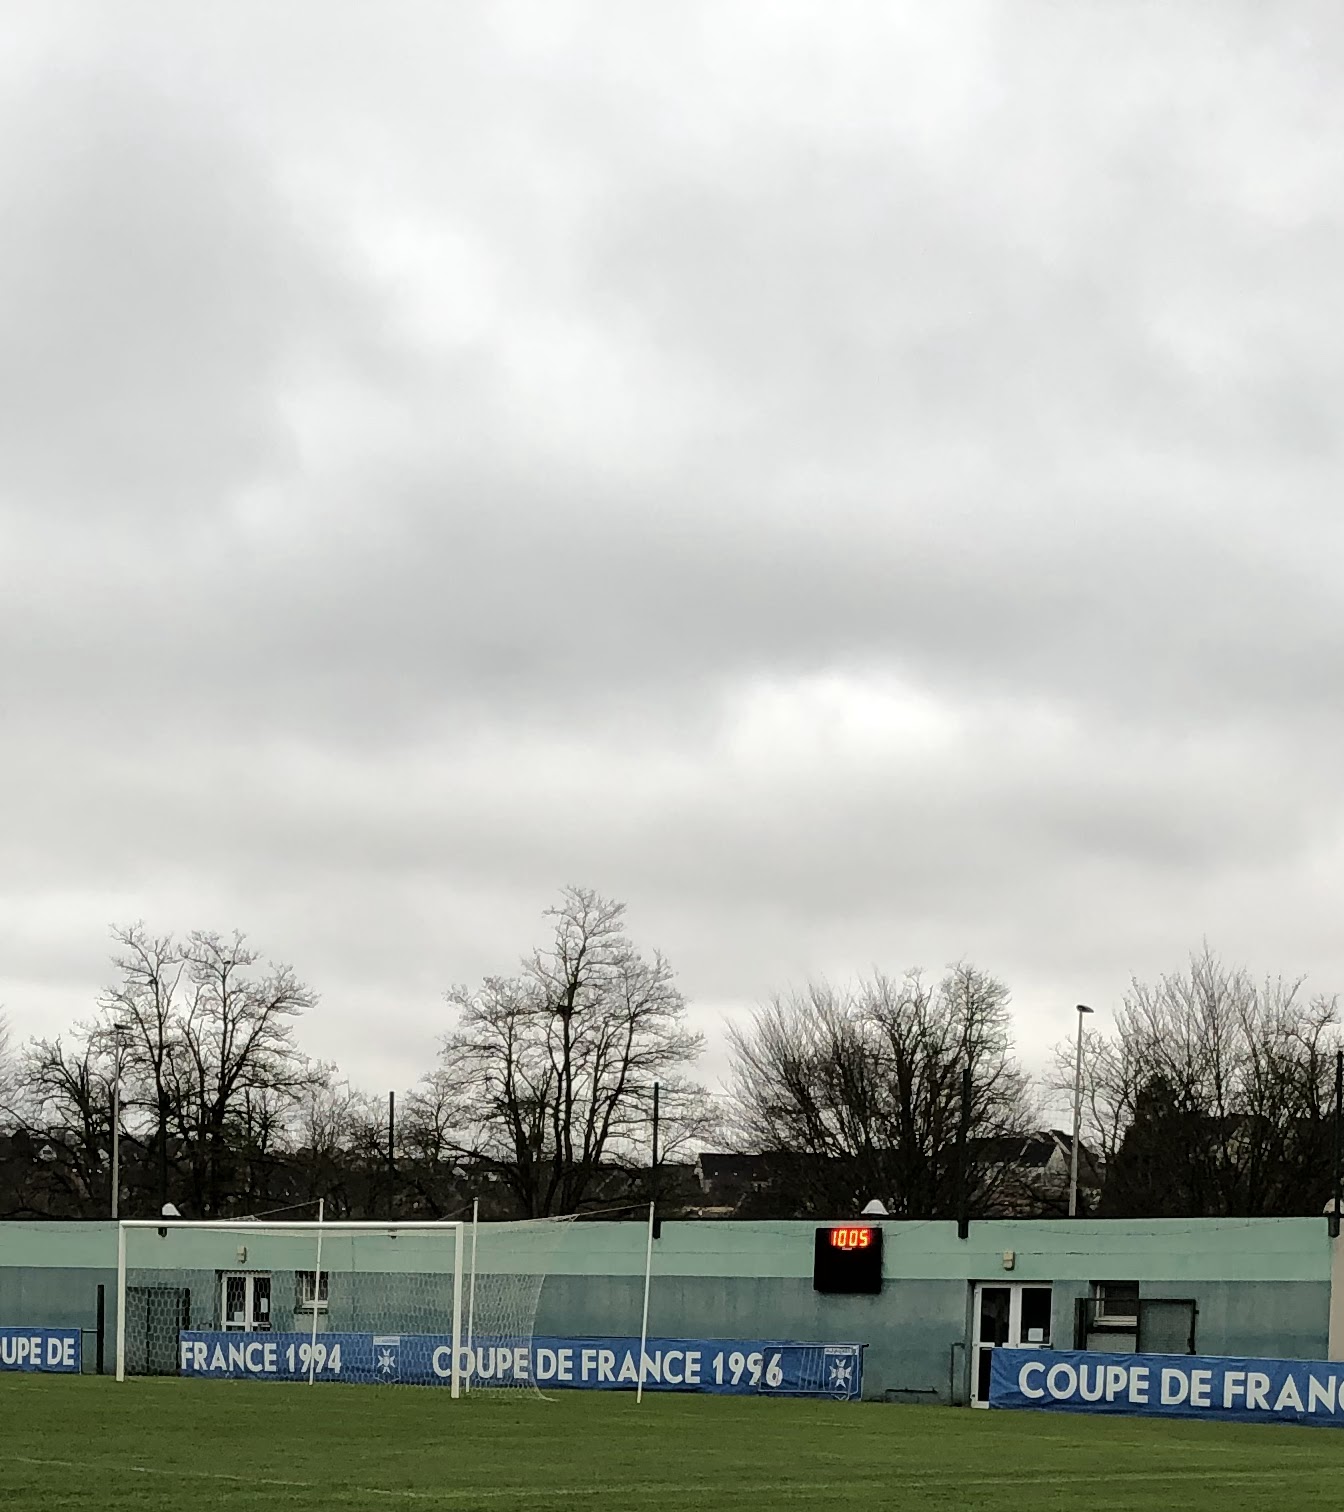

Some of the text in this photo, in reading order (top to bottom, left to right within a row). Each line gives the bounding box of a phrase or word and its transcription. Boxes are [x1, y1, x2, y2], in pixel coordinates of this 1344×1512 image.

[46, 1337, 75, 1366] DE
[180, 1340, 342, 1374] FRANCE 1994
[432, 1345, 783, 1387] COUPE DE FRANCE 1996
[1018, 1361, 1150, 1404] COUPE
[1160, 1367, 1213, 1407] DE
